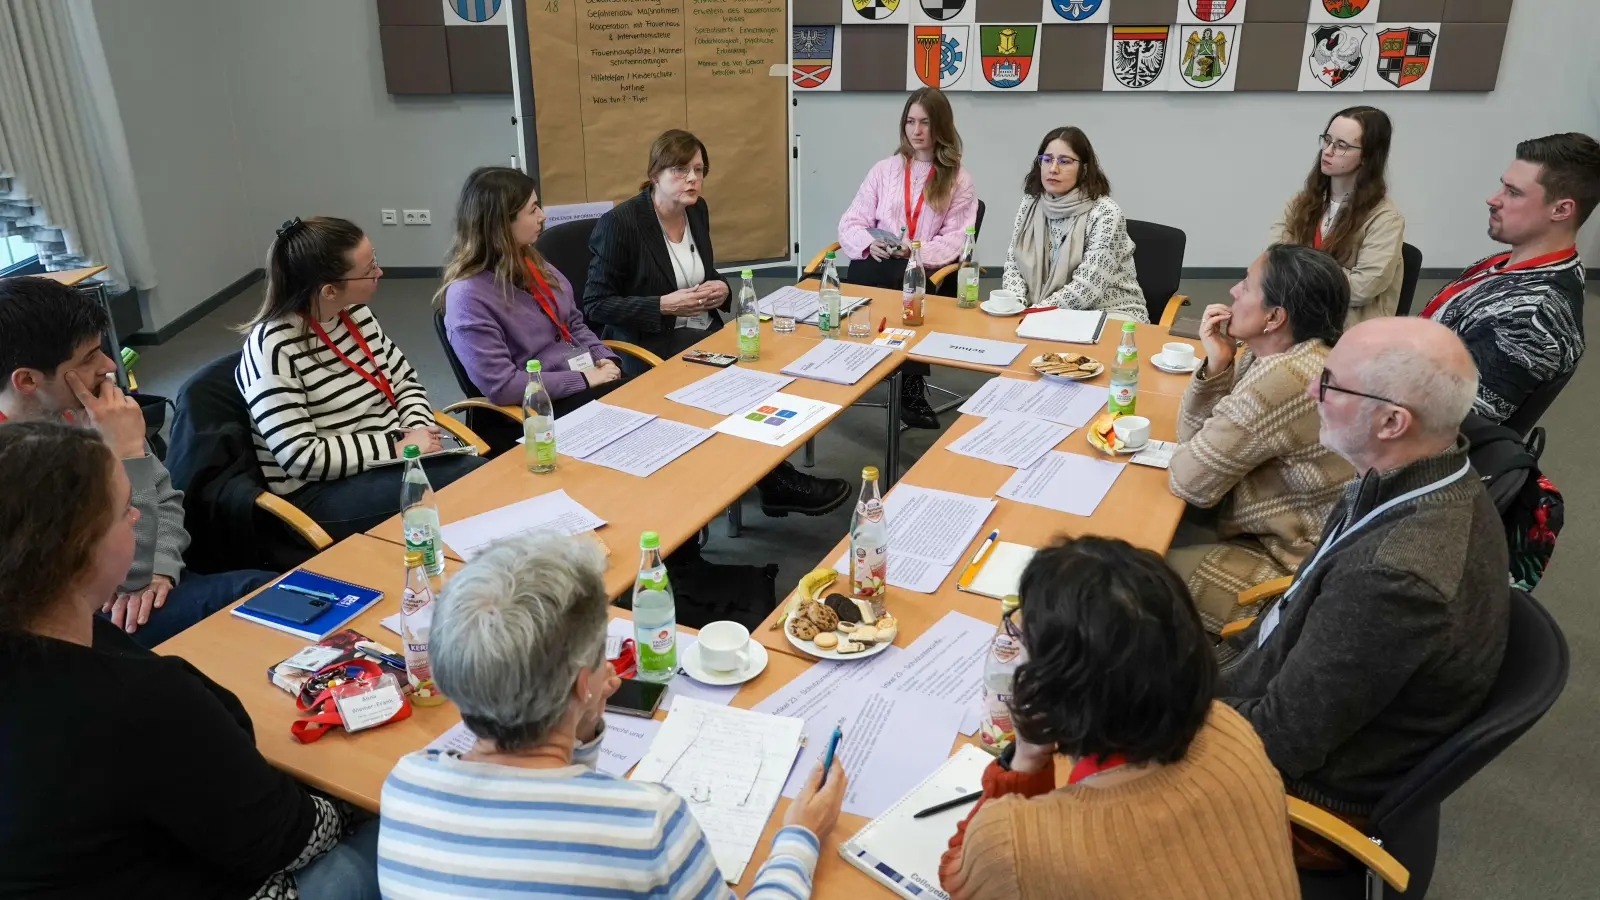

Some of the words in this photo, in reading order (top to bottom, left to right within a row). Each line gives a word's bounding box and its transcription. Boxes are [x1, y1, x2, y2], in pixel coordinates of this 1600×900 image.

[544, 1, 559, 13] 18
[637, 8, 680, 16] Maßnahmen
[589, 22, 629, 31] Kooperation
[645, 20, 680, 28] Frauenhaus
[591, 74, 624, 82] Hilfetelefon
[593, 96, 608, 104] Was
[949, 344, 986, 353] Schutz
[772, 702, 790, 716] Artikel
[911, 873, 950, 900] Collegeblo
